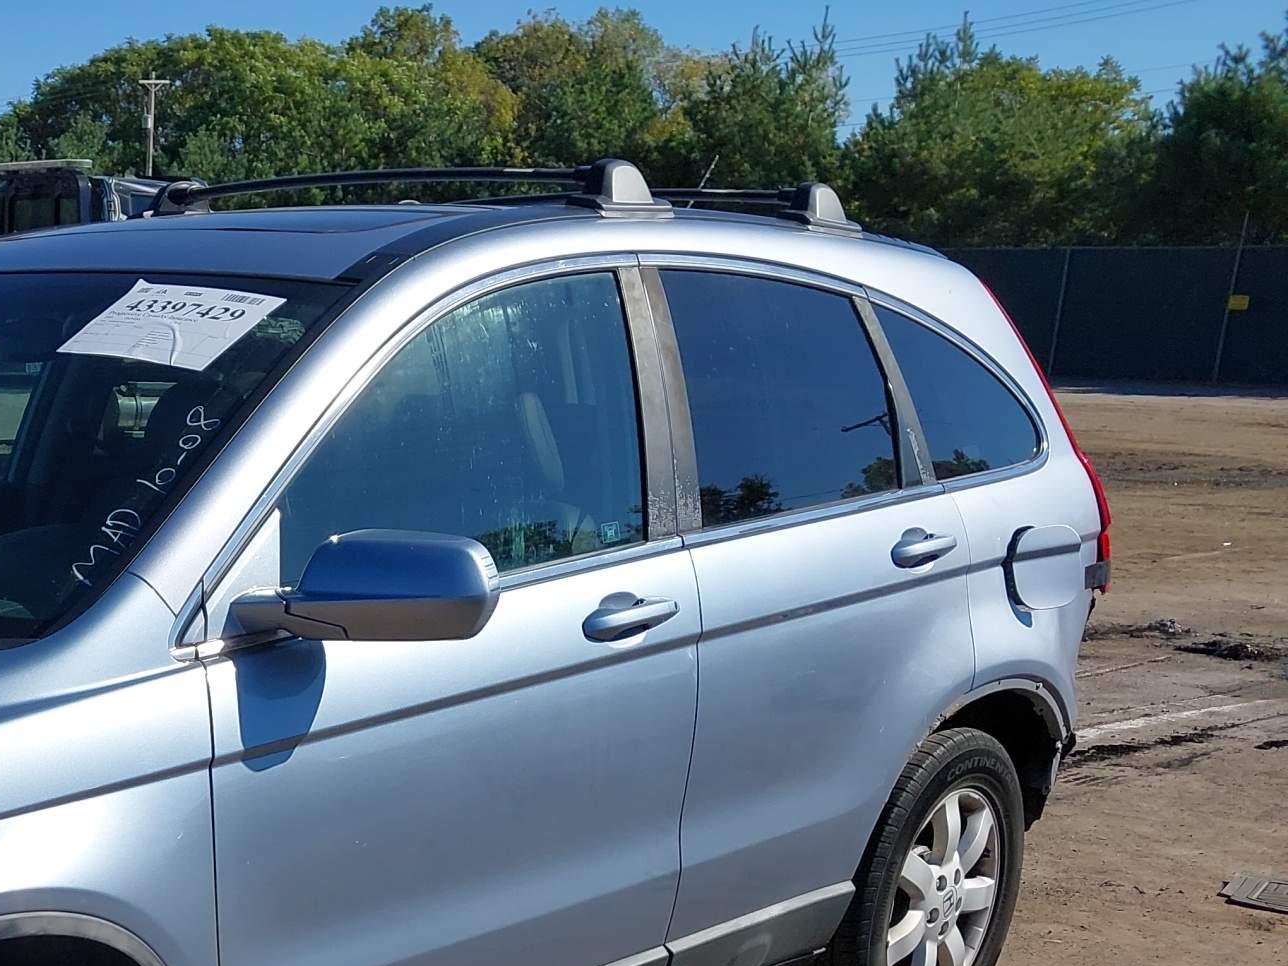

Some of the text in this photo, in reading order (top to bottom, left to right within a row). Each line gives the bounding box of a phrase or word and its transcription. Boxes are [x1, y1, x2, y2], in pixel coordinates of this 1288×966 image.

[125, 298, 246, 322] 43397429
[71, 508, 142, 586] MAD
[135, 405, 220, 495] 10-08
